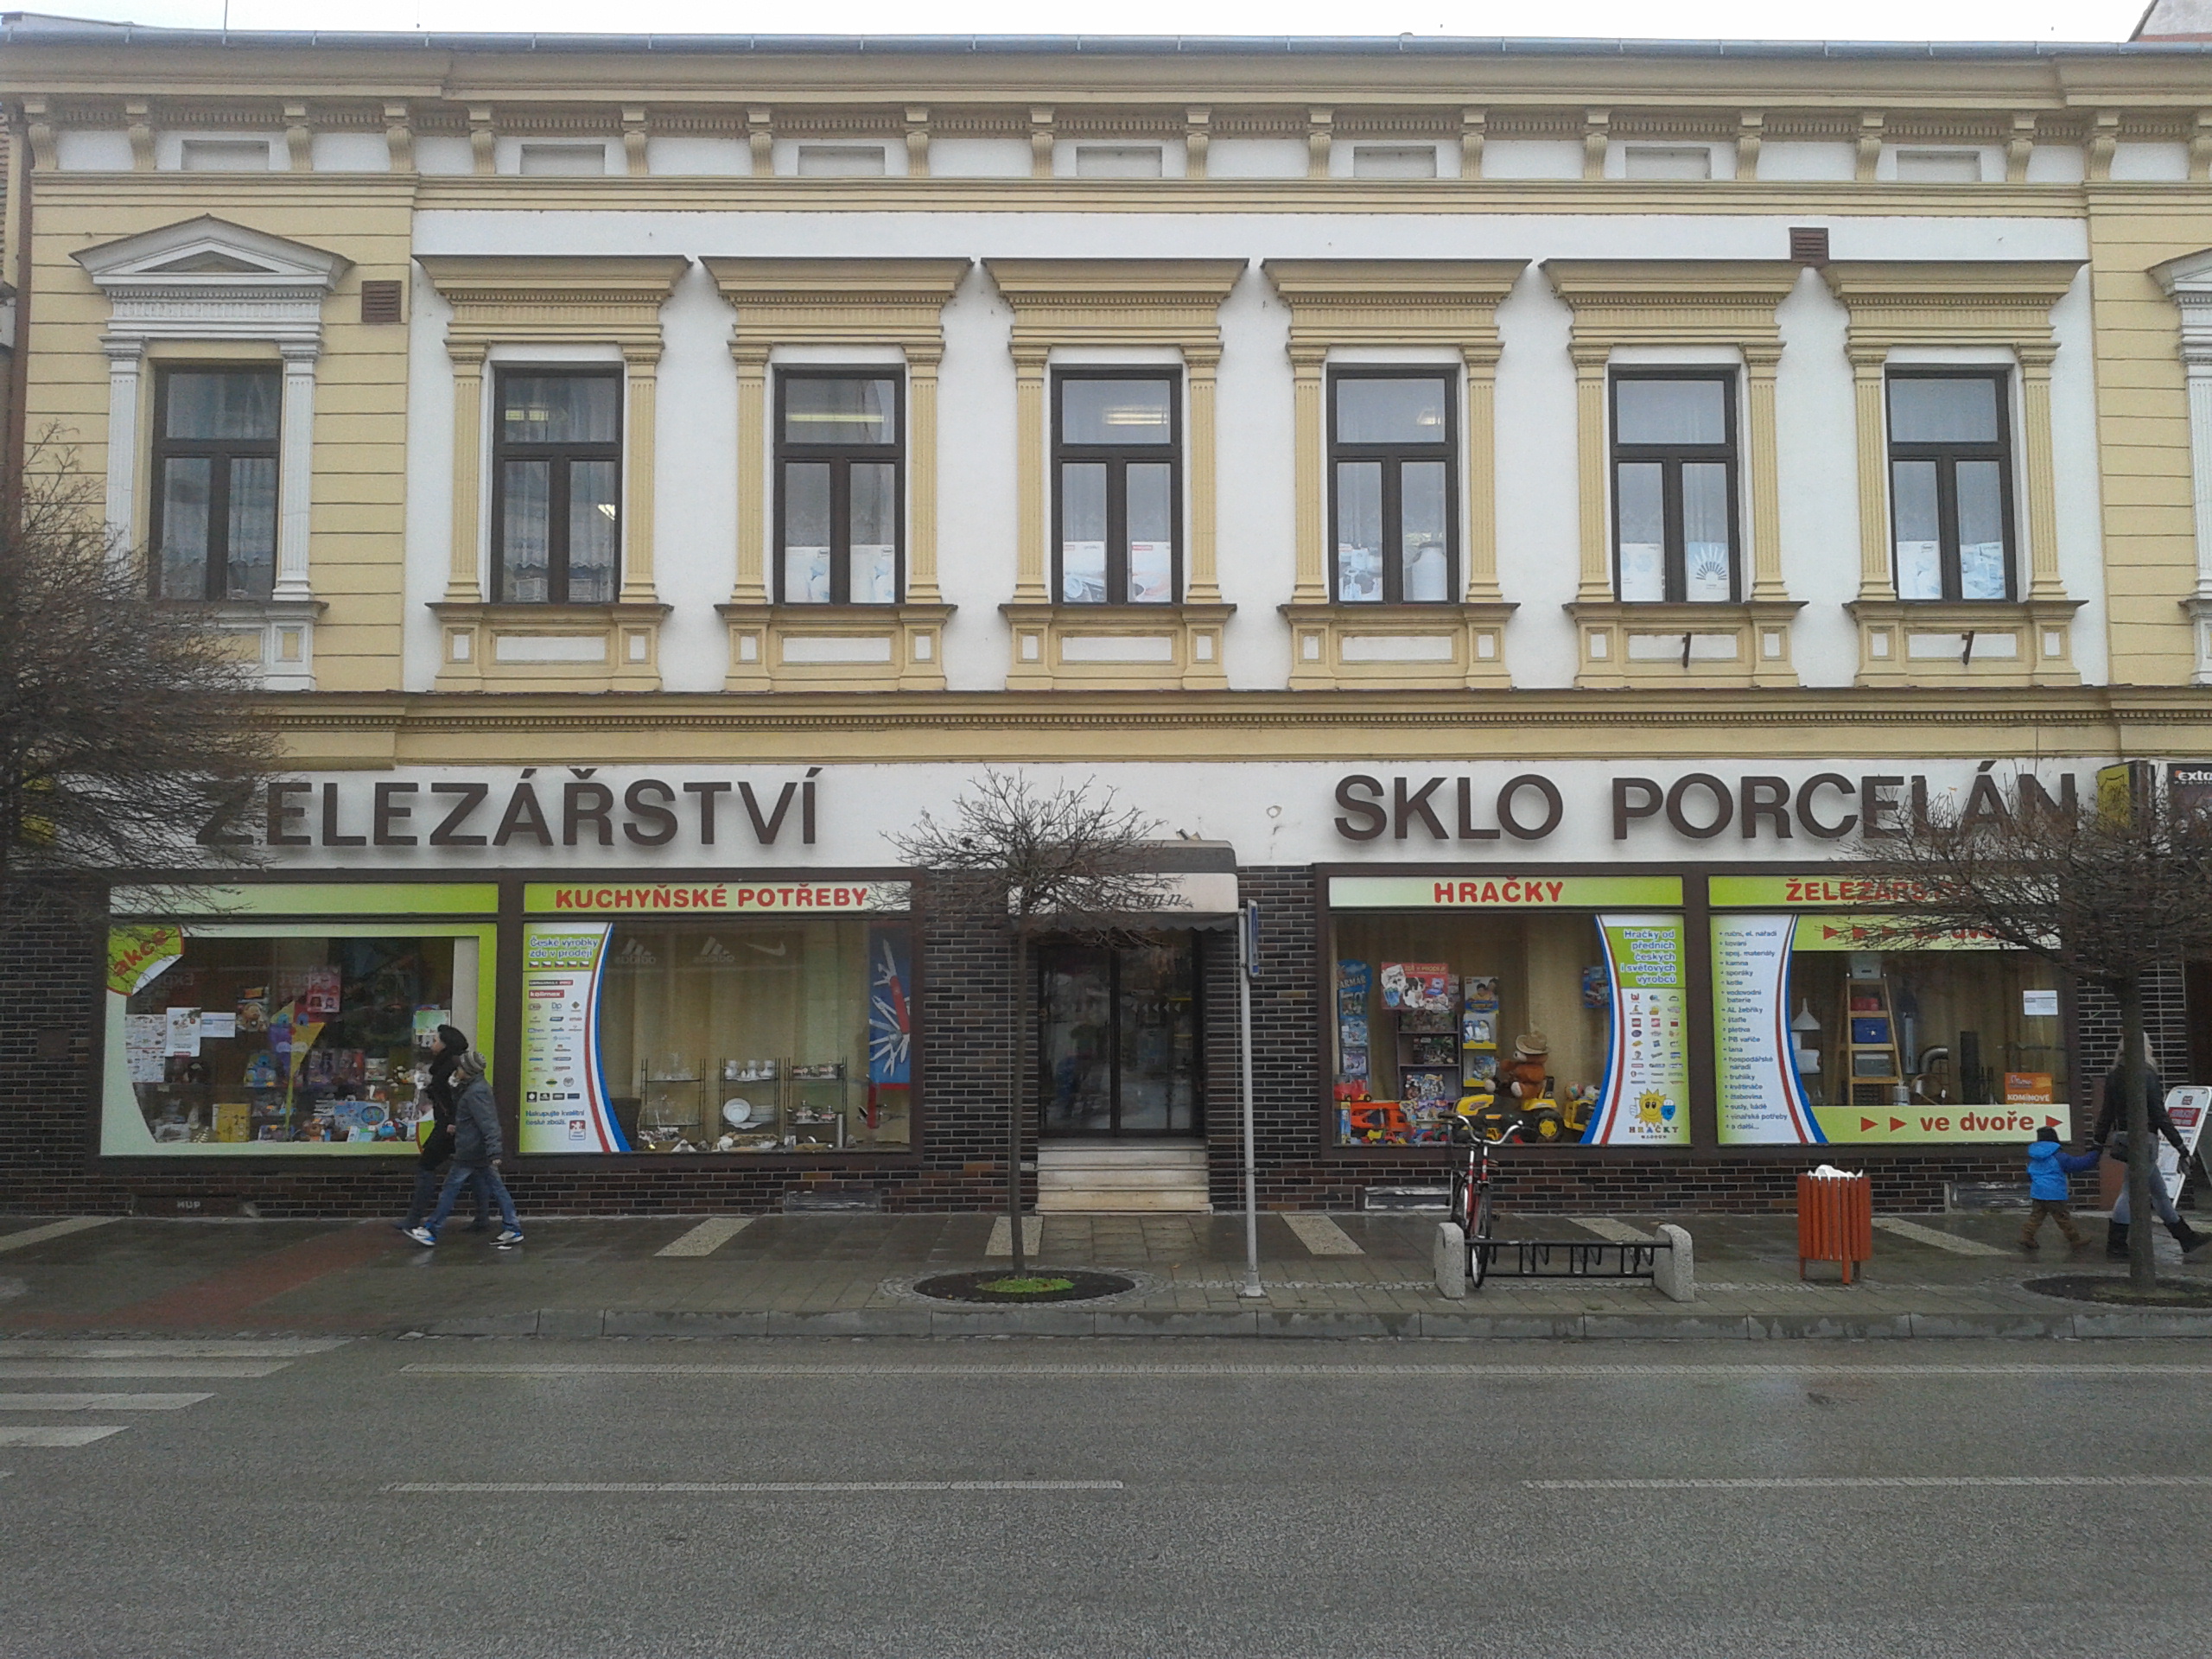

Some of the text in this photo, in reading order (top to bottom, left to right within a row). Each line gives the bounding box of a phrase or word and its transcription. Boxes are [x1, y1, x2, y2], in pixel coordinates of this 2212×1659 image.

[1335, 760, 2075, 841] SKLO PORCELÁN
[556, 882, 868, 908] KUCHYŇSKÉ POTŘEBY
[1434, 876, 1564, 904] HRAČKY
[1624, 930, 1675, 939] Hračky od
[530, 936, 599, 948] České výrobky
[1632, 941, 1675, 950] předních
[113, 930, 168, 977] akce
[558, 949, 593, 958] prodeji
[1635, 952, 1675, 962] českých
[1627, 963, 1675, 973] světových
[1637, 974, 1676, 984] výrobců
[1920, 1110, 2035, 1132] ve dvoře
[1629, 1124, 1679, 1133] HRAČKY
